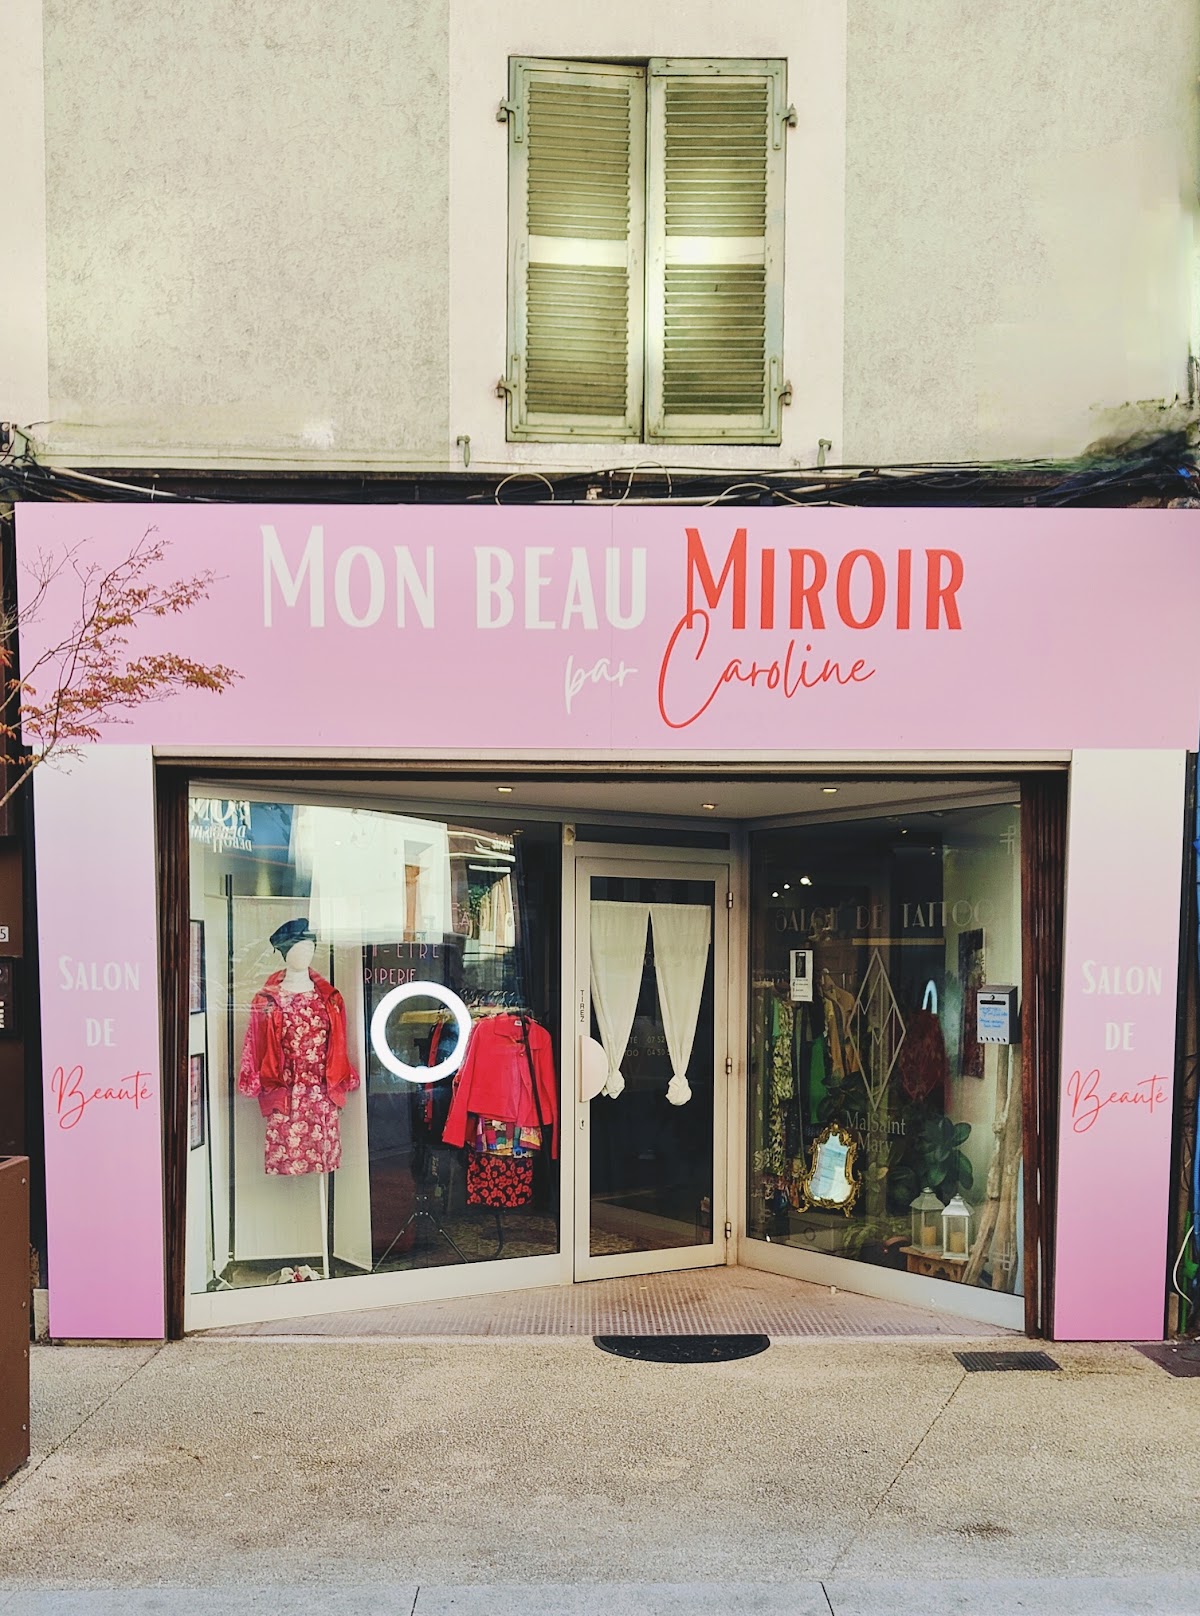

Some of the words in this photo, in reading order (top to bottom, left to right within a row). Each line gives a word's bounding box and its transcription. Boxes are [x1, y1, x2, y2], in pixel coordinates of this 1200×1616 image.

[260, 524, 435, 629] MON
[474, 546, 648, 630] BEAU
[684, 528, 965, 630] MIROIR
[564, 655, 639, 715] par
[658, 608, 876, 729] Caroline
[58, 954, 141, 992] SALON
[1082, 959, 1163, 996] SALON
[85, 1017, 117, 1047] DE
[1104, 1022, 1137, 1051] DE
[51, 1065, 153, 1130] Beauté
[1066, 1069, 1169, 1134] Beauté
